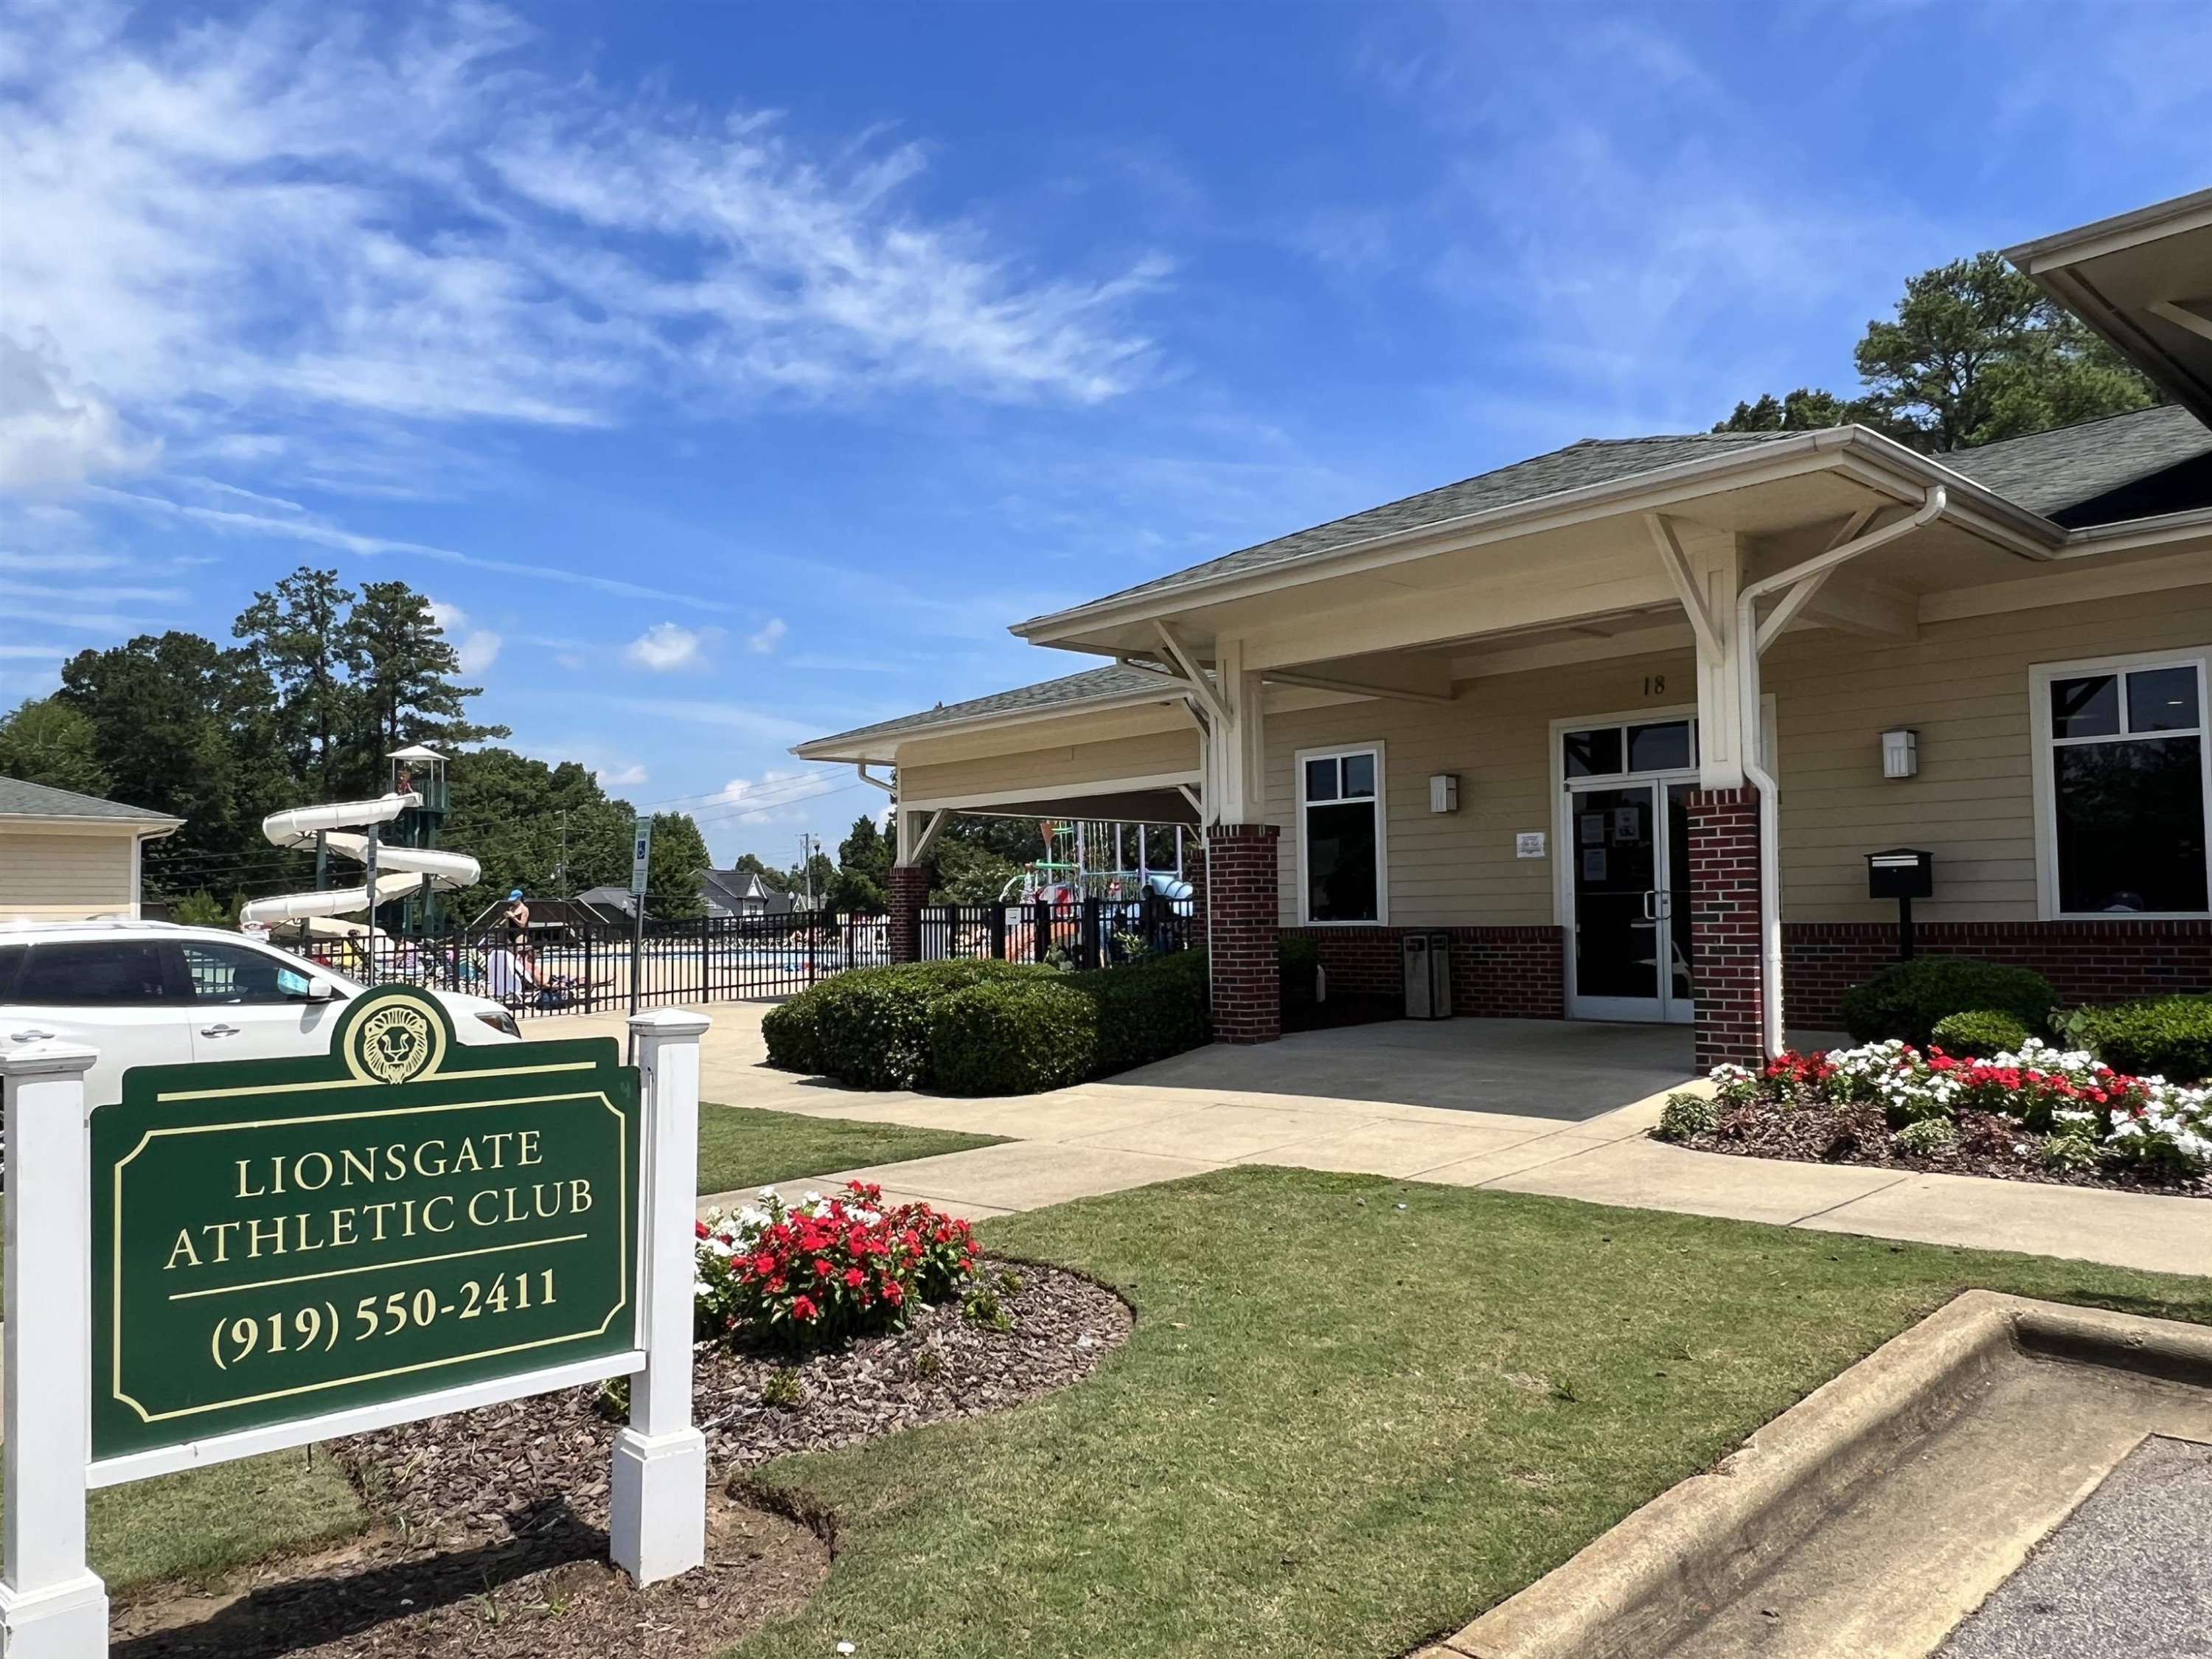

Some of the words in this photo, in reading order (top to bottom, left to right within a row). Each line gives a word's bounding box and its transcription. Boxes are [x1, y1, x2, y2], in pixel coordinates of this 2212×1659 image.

[1644, 675, 1665, 695] 18
[235, 1130, 543, 1198] LIONSGATE
[163, 1196, 454, 1270] ATHLETIC
[468, 1179, 593, 1226] CLUB
[212, 1301, 339, 1370] (919)
[355, 1268, 557, 1341] 550-2411
